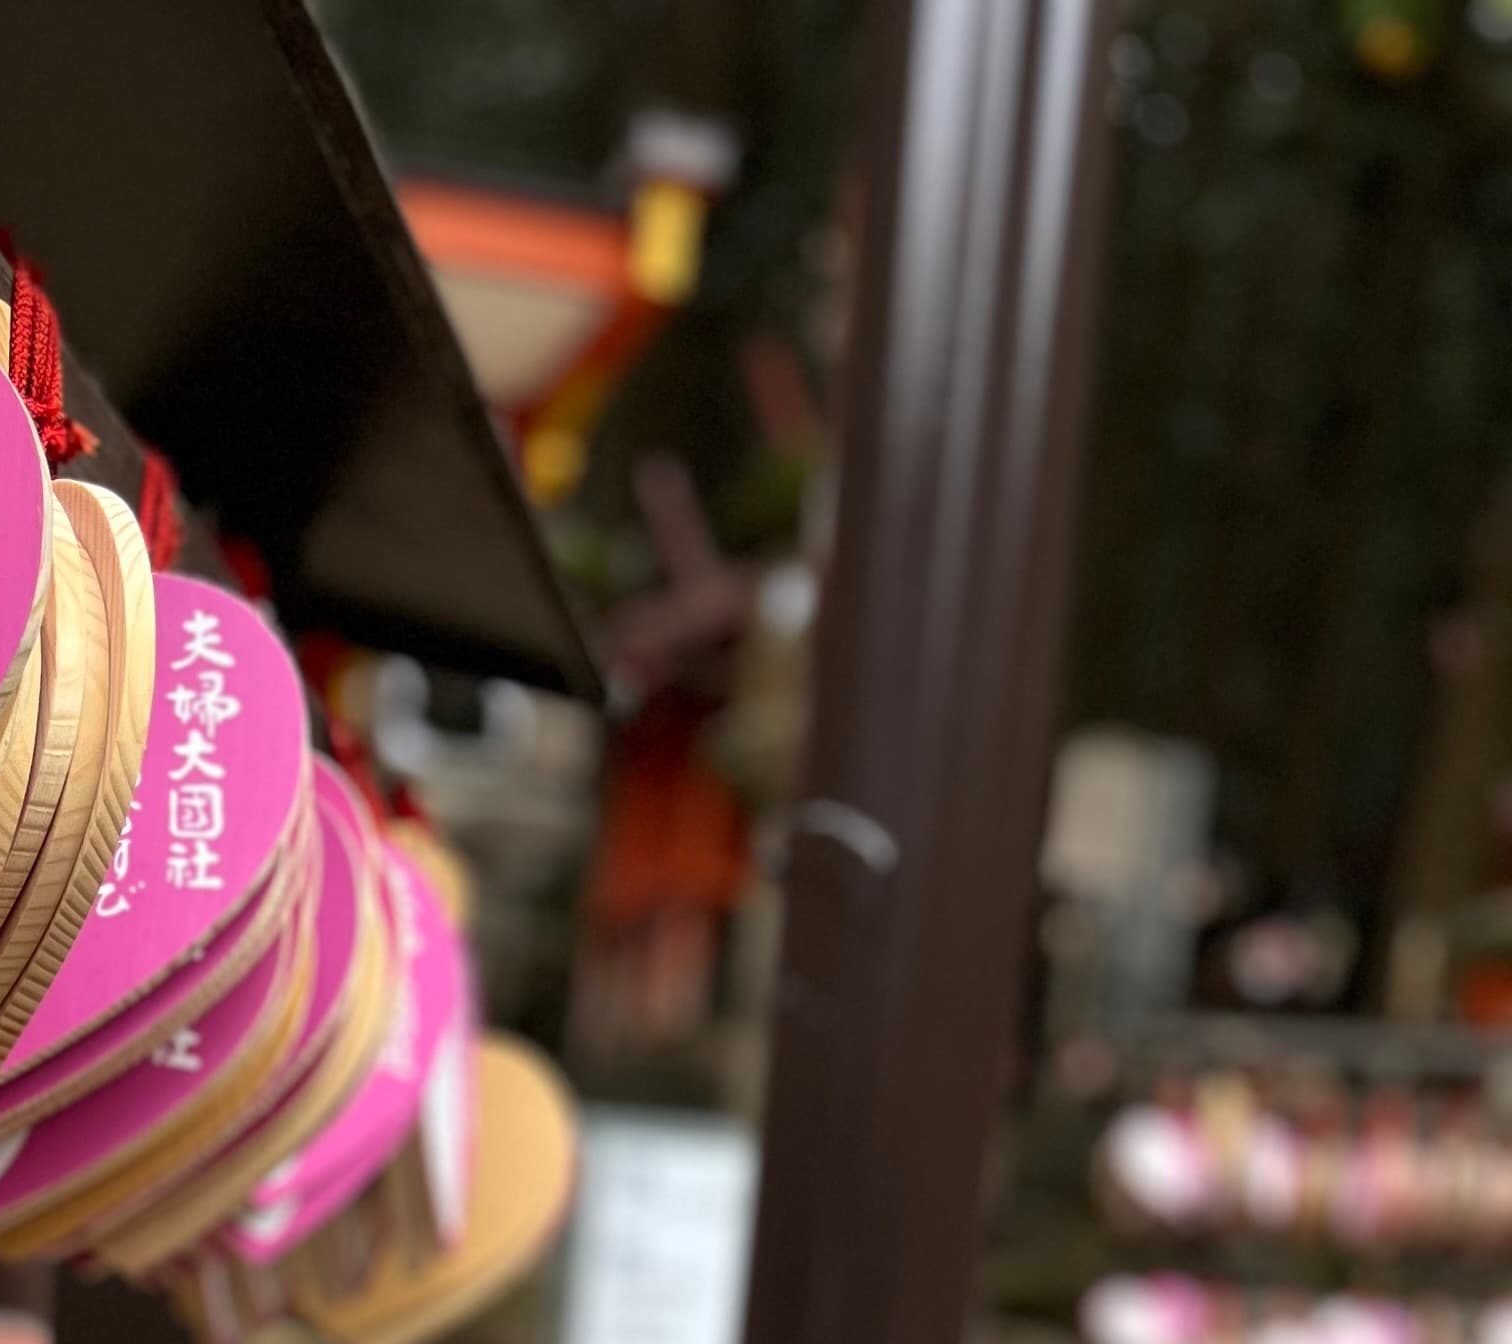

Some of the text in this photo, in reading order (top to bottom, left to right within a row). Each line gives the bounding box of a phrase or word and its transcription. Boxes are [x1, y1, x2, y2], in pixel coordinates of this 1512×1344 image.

[165, 608, 241, 890] 夫婦大國社
